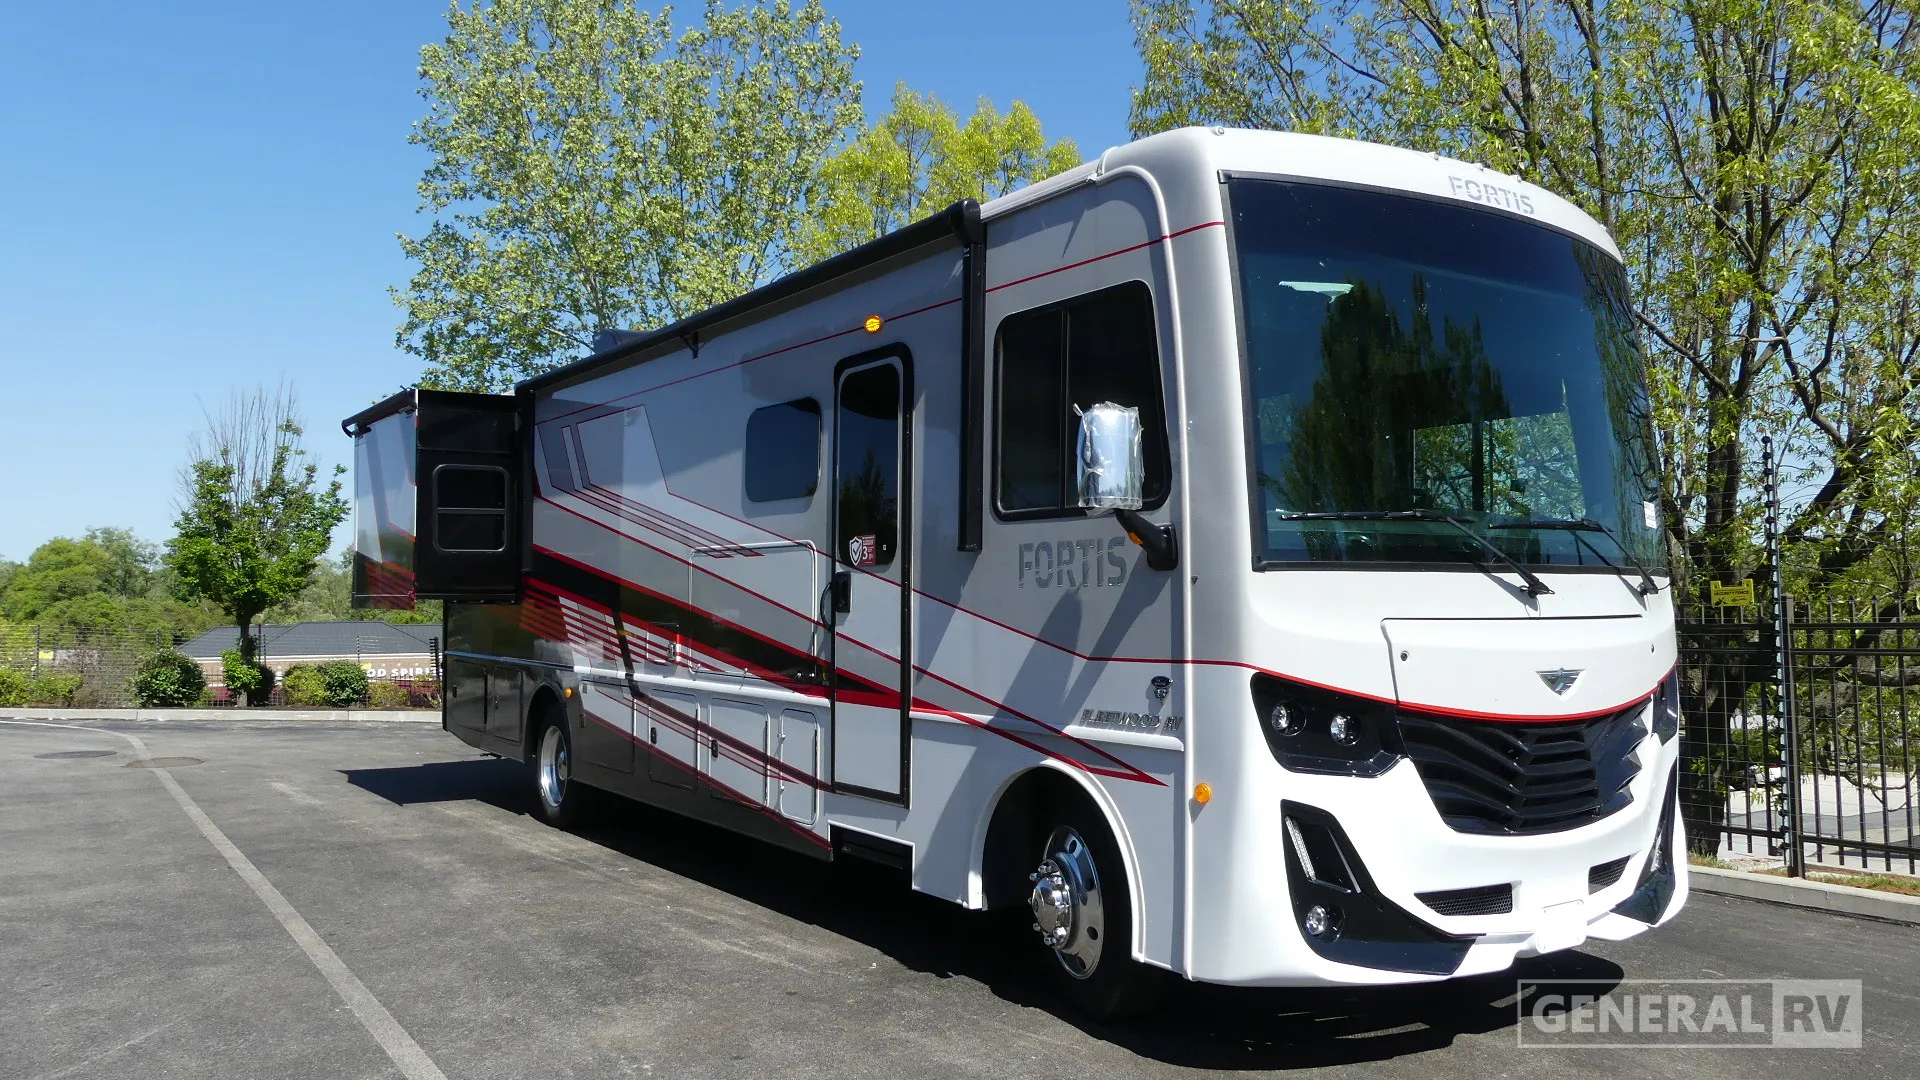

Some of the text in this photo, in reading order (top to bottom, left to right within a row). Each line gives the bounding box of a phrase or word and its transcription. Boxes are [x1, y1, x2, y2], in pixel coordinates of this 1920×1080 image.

[1448, 175, 1535, 215] FORTIS
[1018, 536, 1128, 589] FORTIS
[1081, 709, 1161, 728] FLEETWOOD
